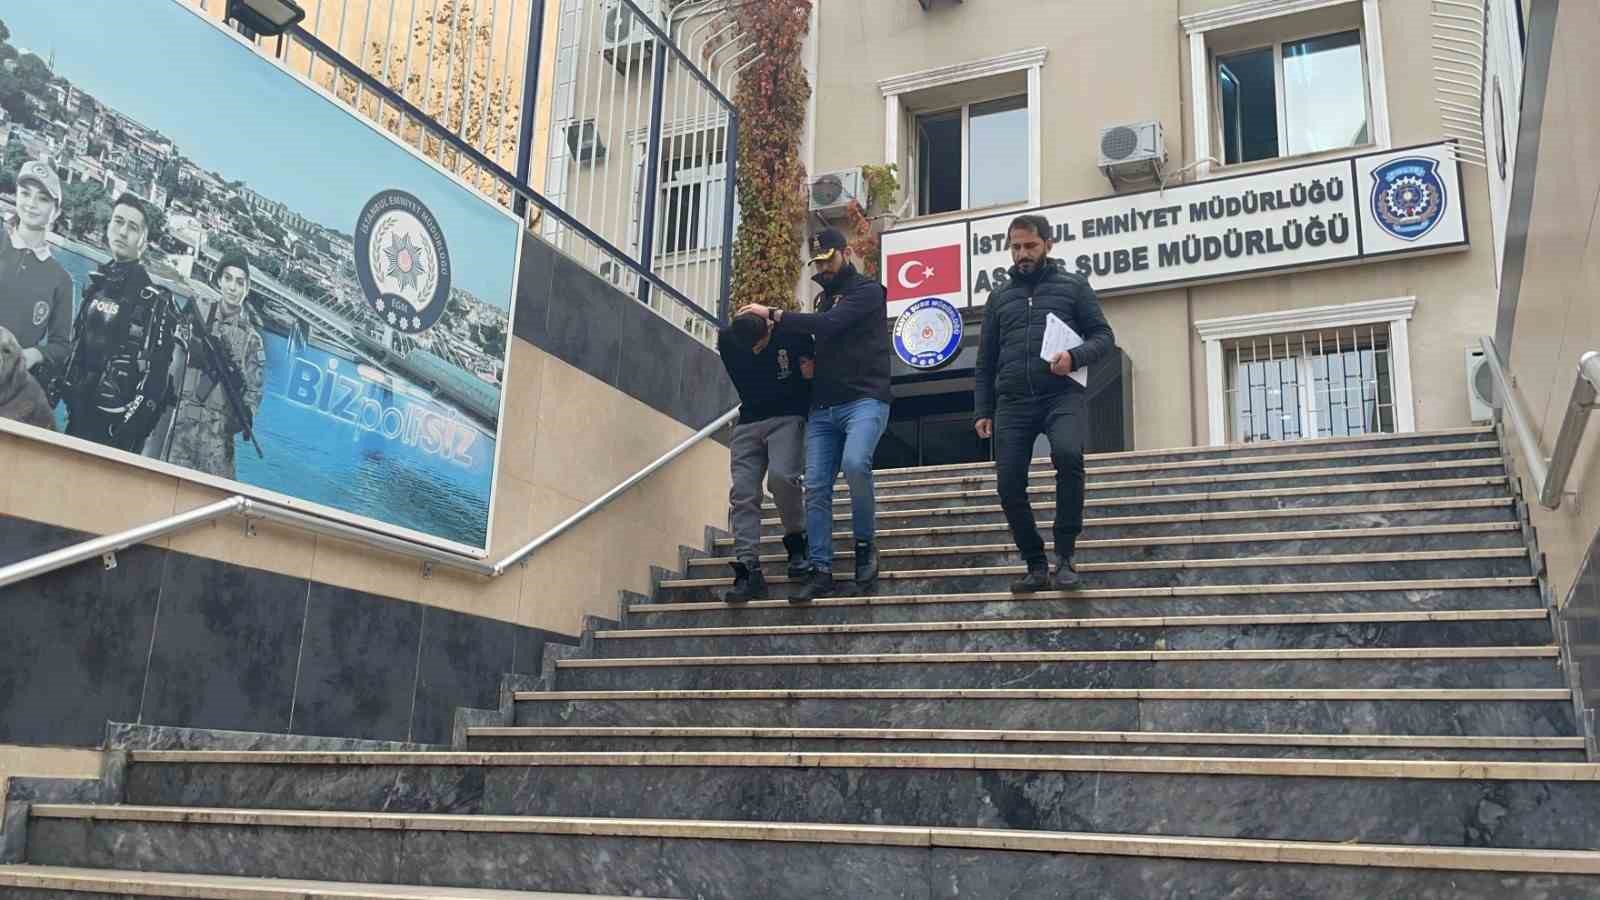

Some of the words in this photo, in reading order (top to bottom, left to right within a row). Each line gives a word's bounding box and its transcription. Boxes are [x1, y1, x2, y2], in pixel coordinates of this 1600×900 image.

[973, 222, 1076, 257] İSTUL
[1082, 205, 1182, 239] EMNİYET
[1189, 176, 1344, 223] MÜDÜRLÜĞÜ
[1158, 213, 1350, 268] MÜDÜRLÜĞÜ
